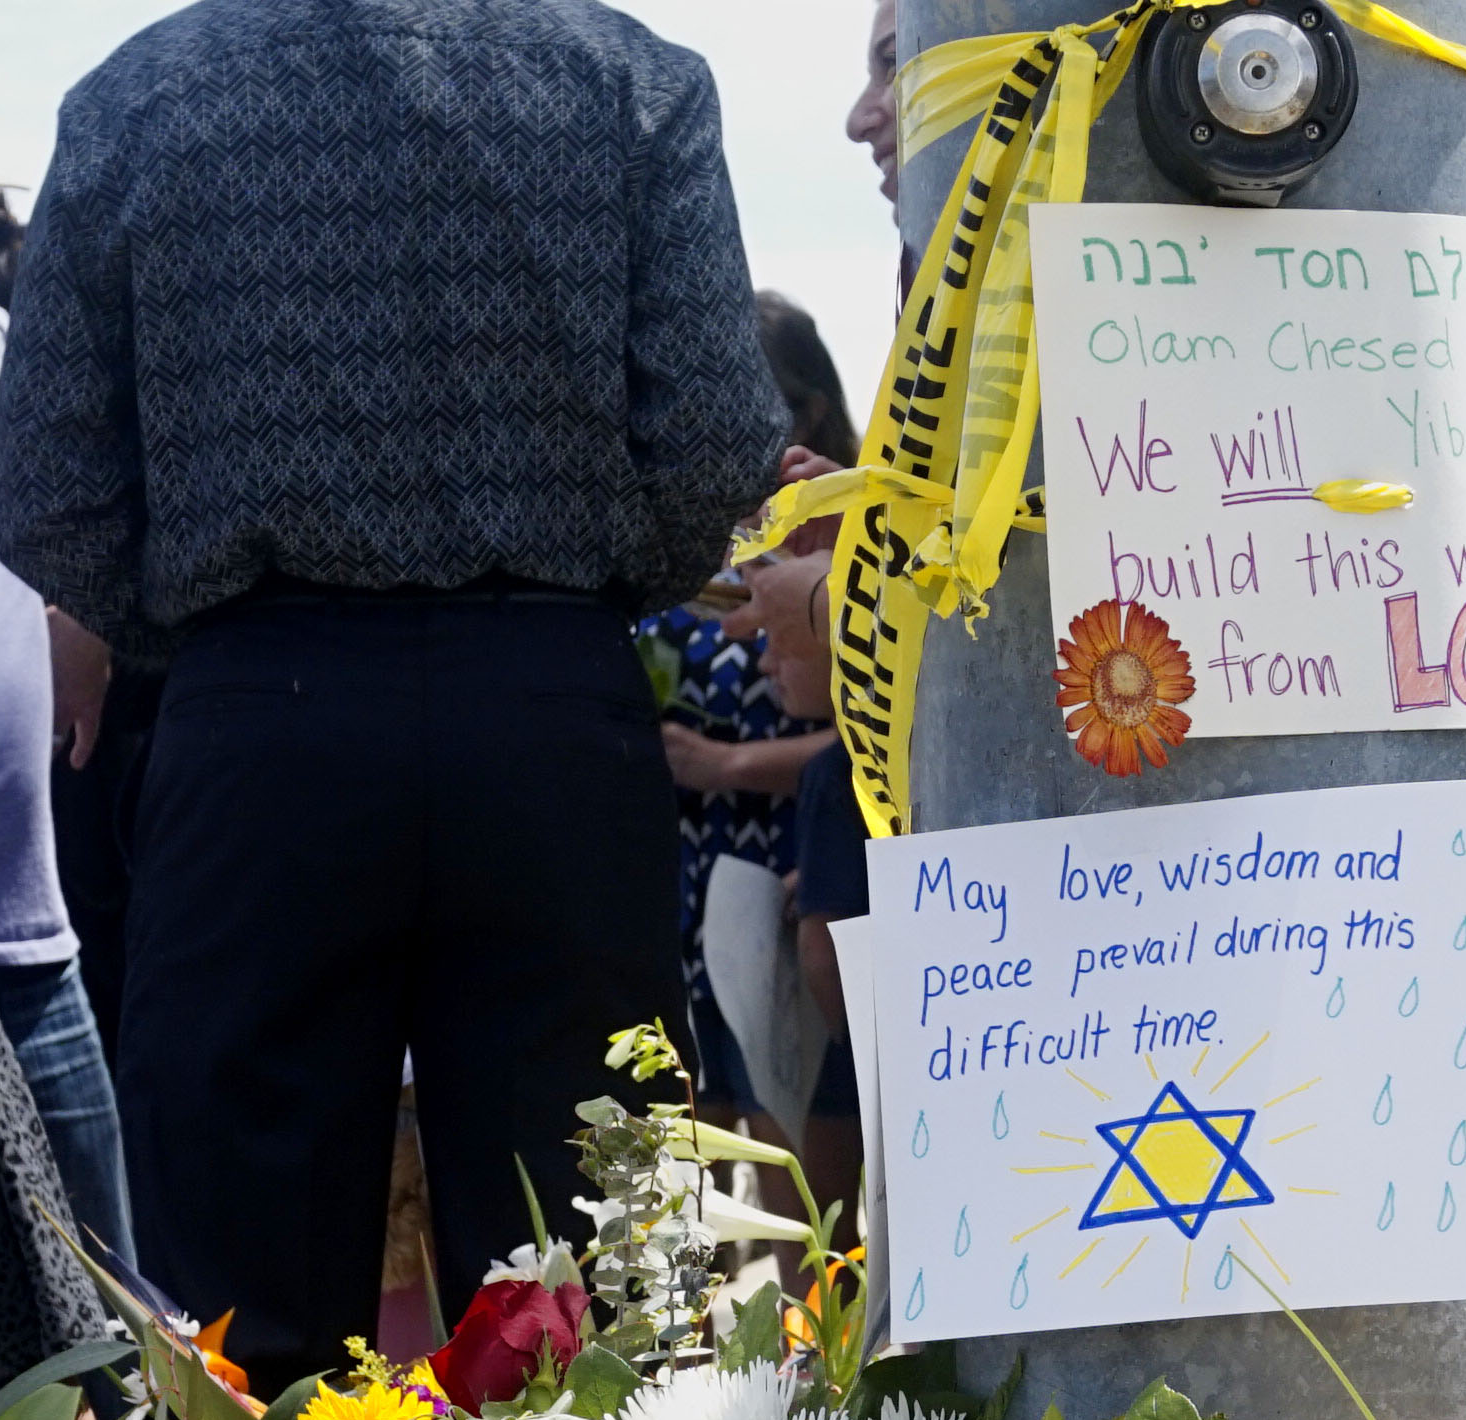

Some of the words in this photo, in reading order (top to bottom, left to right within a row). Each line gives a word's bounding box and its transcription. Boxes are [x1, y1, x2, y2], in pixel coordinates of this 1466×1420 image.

[1088, 315, 1236, 368] Olam
[1268, 317, 1456, 371] Chesed
[1077, 398, 1178, 497] We
[1210, 405, 1305, 487] will
[1108, 530, 1260, 606] build
[1295, 530, 1405, 597] this
[1208, 619, 1342, 704] from
[915, 857, 1009, 944] May
[1059, 843, 1145, 908] love,
[1159, 831, 1320, 893] wisdom
[1334, 829, 1404, 882] and
[921, 953, 1034, 1026] peace
[1072, 920, 1199, 997] prevail
[1214, 914, 1329, 976] during
[1344, 909, 1416, 952] this
[928, 1009, 1111, 1082] difficult
[1133, 1003, 1225, 1055] time.
